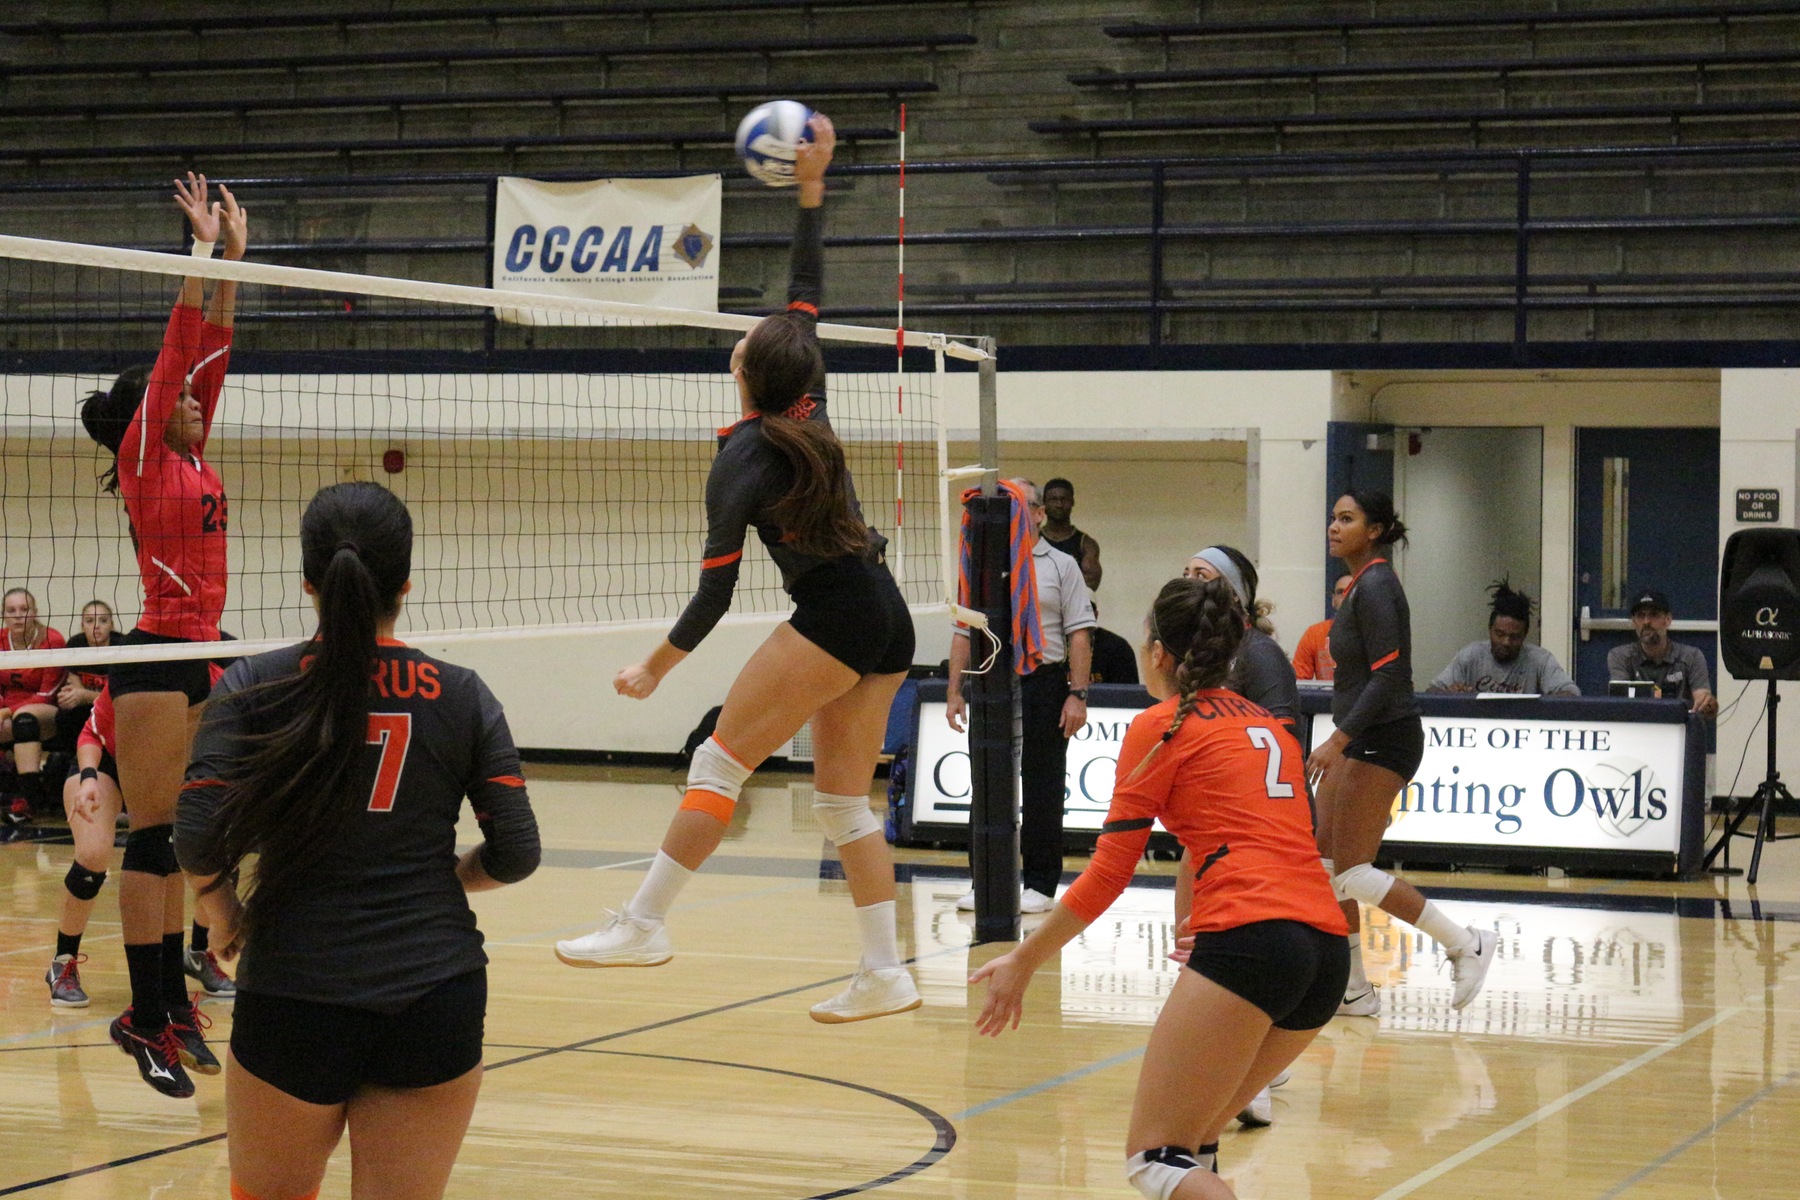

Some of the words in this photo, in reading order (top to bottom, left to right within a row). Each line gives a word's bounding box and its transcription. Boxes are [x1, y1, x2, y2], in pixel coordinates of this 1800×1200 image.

[504, 224, 664, 273] CCCAA
[1738, 492, 1751, 500] NO
[1753, 492, 1777, 500] FOOD
[1742, 510, 1773, 519] DRINKS
[1751, 501, 1764, 510] OR
[1427, 726, 1477, 748] ME
[1487, 727, 1531, 749] OF
[1539, 728, 1611, 751] THE
[365, 712, 412, 812] 7
[1246, 726, 1295, 799] 2
[1543, 767, 1667, 821] Owls
